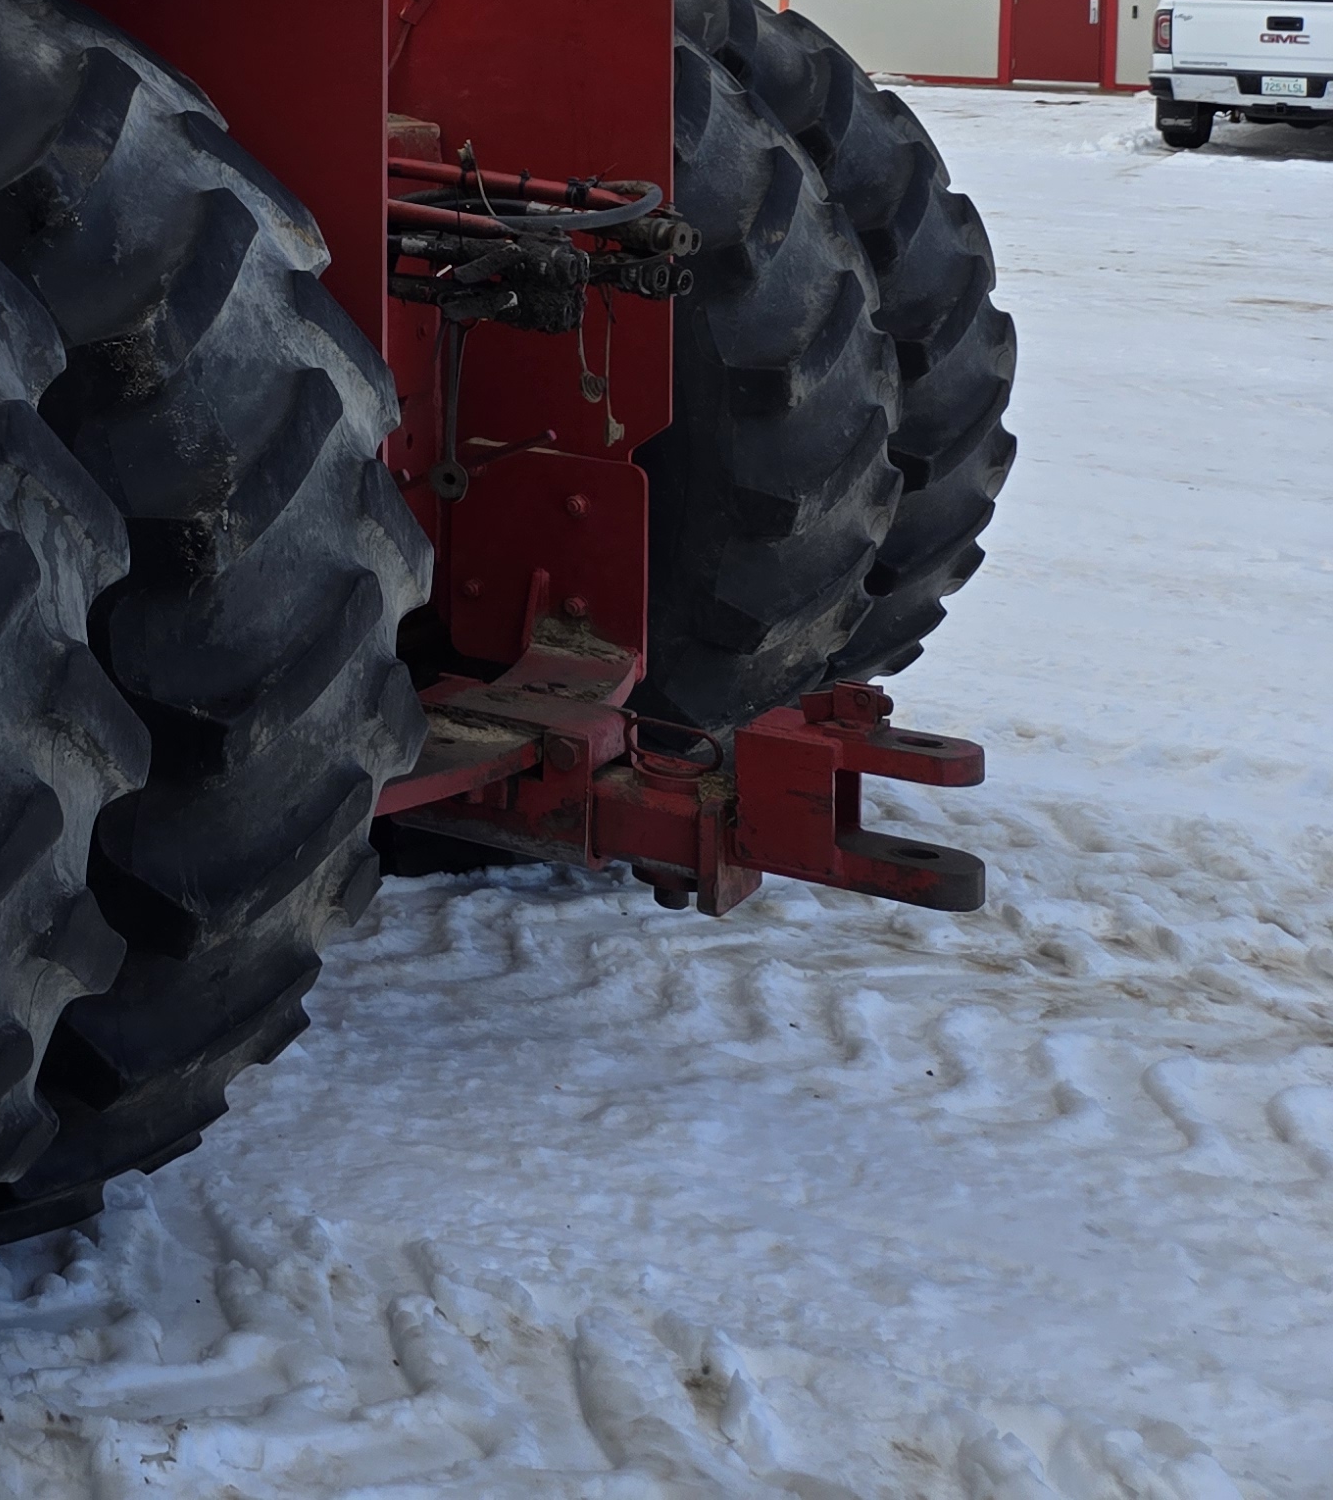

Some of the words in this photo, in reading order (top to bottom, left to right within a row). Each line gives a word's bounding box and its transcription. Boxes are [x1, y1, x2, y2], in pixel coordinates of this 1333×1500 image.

[1259, 33, 1310, 45] GMC
[1264, 82, 1281, 92] 725
[1287, 83, 1304, 93] LSL
